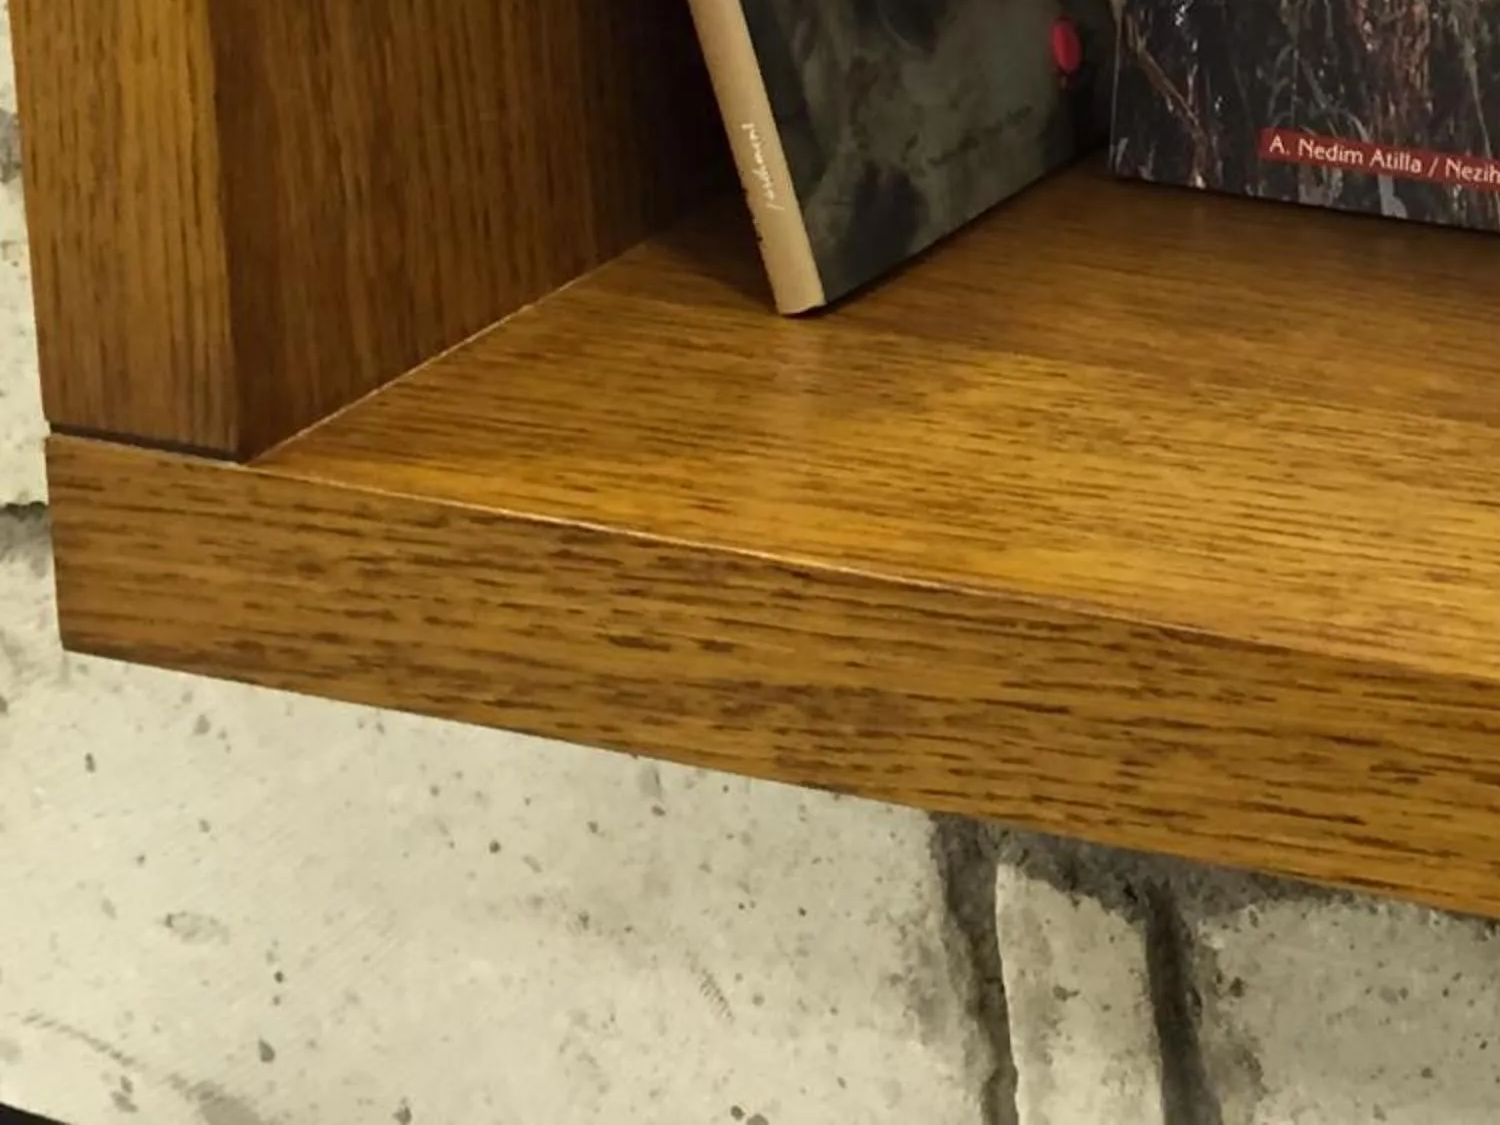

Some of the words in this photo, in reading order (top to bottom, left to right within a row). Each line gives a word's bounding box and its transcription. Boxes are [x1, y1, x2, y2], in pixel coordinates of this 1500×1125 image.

[1268, 135, 1290, 155] A.
[1299, 138, 1363, 166] Nedim
[1370, 148, 1422, 173] Atilla
[1445, 157, 1500, 185] Nezih
